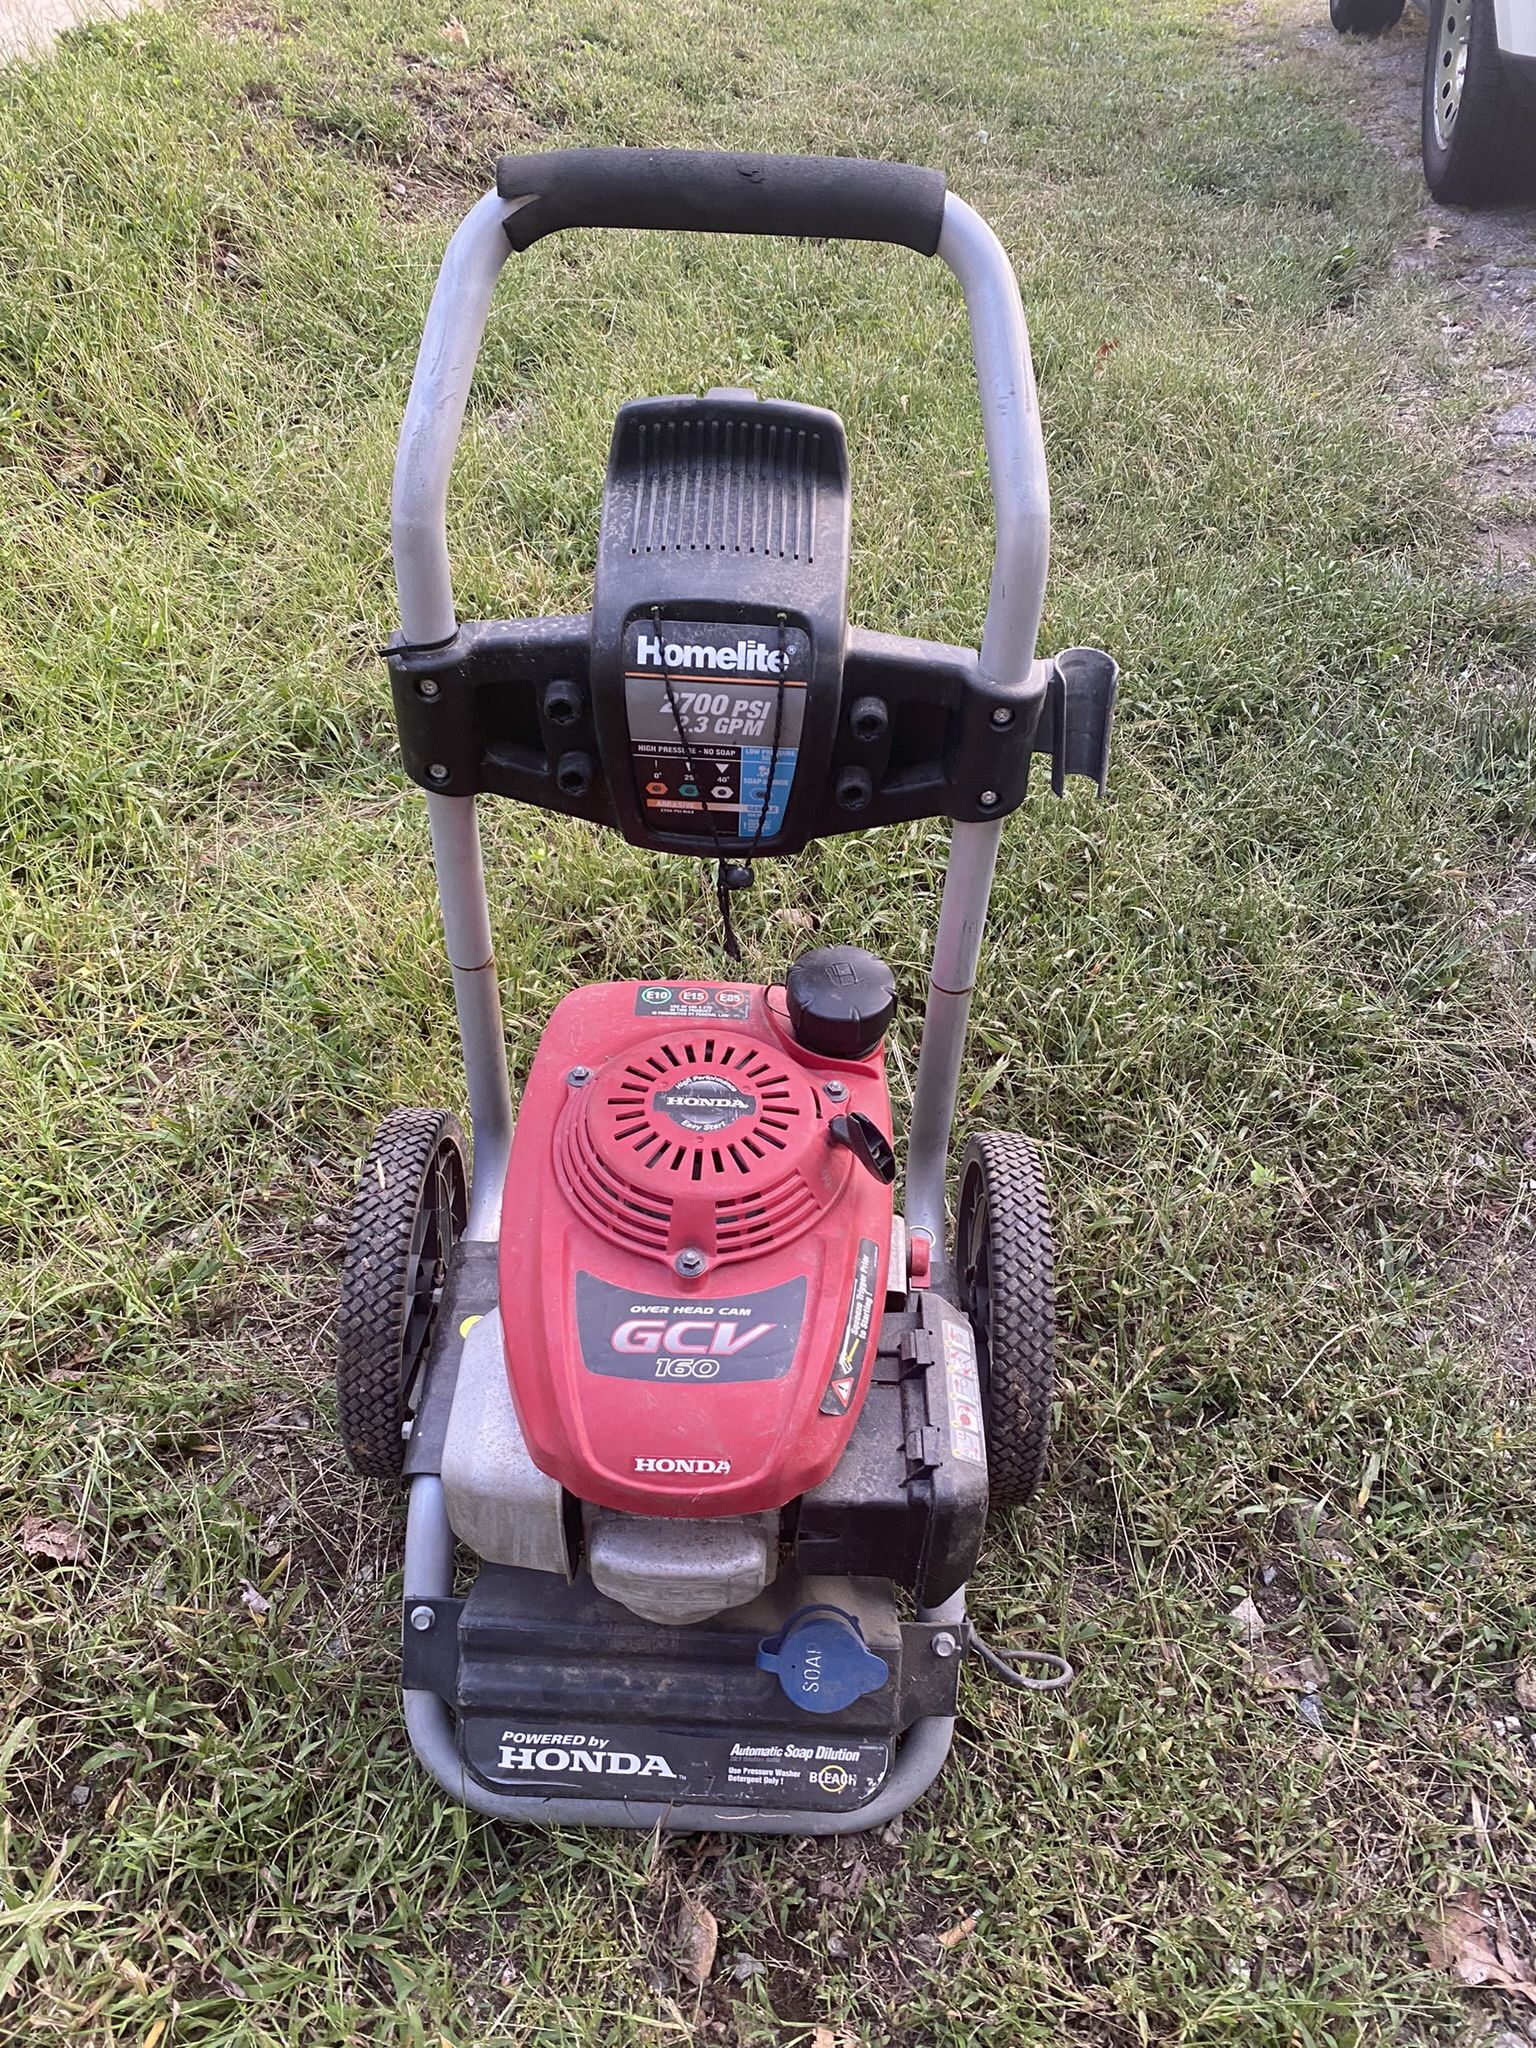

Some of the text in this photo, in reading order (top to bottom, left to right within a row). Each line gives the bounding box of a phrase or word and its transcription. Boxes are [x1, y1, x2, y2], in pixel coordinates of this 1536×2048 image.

[659, 692, 772, 720] 2700 PSI
[714, 717, 766, 737] GPM
[638, 745, 656, 753] HIGH
[703, 748, 714, 756] NO
[716, 749, 736, 757] SOAP
[646, 991, 668, 999] E10
[683, 992, 704, 1000] E15
[719, 993, 741, 1002] E85
[675, 1076, 692, 1090] High
[666, 1096, 749, 1109] HONDA
[681, 1119, 727, 1131] Easy Start
[850, 1254, 870, 1336] Squeeze Trigger Prior
[630, 1305, 751, 1316] OVER HEAD CAM
[860, 1297, 874, 1330] Starting
[611, 1319, 777, 1355] GCV
[859, 1331, 867, 1340] to
[655, 1358, 720, 1378] 160
[634, 1457, 731, 1474] HONDA
[501, 1731, 609, 1749] POWERED by
[730, 1743, 860, 1762] Automatic Soap Dilution
[497, 1745, 677, 1779] HONDA
[743, 1767, 774, 1776] Pressure
[775, 1768, 801, 1778] Washer
[809, 1772, 857, 1786] BLEACH
[727, 1774, 762, 1784] Detergent
[763, 1776, 780, 1786] Only
